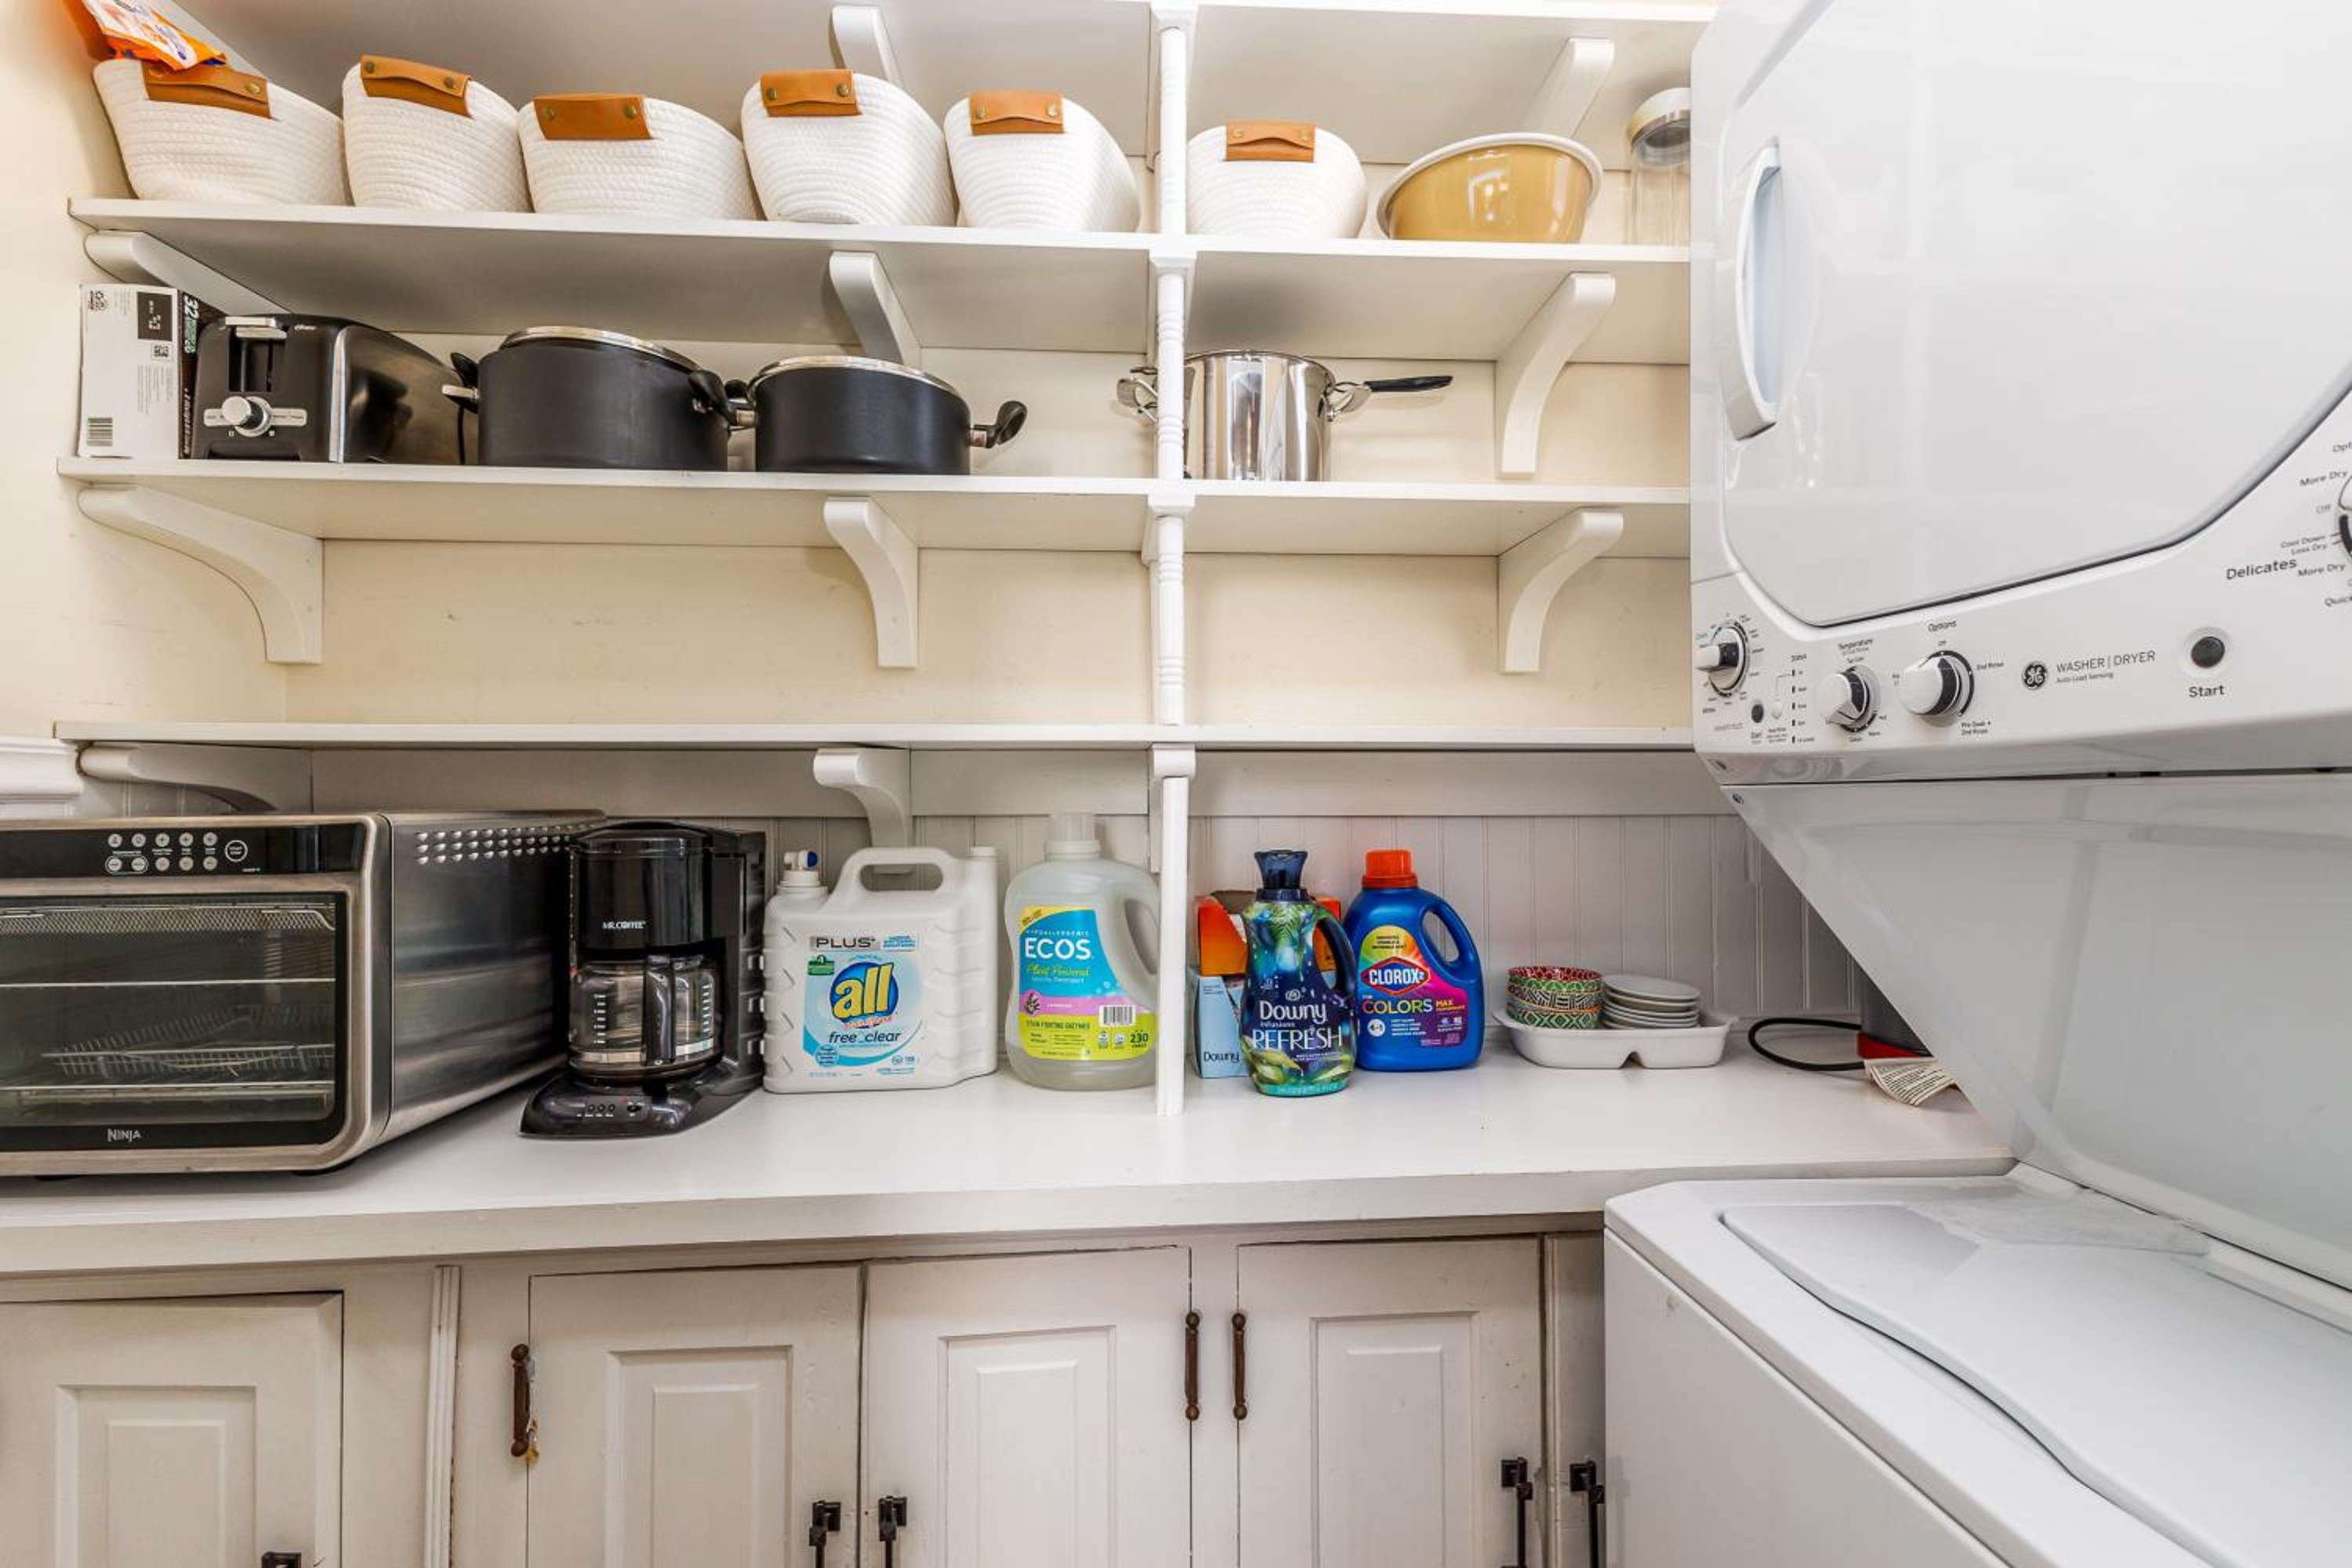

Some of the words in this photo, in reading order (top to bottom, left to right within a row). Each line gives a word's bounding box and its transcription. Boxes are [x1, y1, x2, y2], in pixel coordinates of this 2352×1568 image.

[2300, 475, 2326, 486] More
[2329, 470, 2347, 480] Dry
[2316, 504, 2332, 514] Off
[2281, 539, 2299, 548] Cool
[2301, 535, 2326, 545] Down
[2313, 543, 2328, 552] Dry
[2226, 558, 2297, 580] Delicates
[2298, 567, 2325, 577] More
[2327, 563, 2346, 572] Dry
[1928, 620, 1957, 632] Options
[2056, 658, 2105, 673] WASHER
[2114, 650, 2155, 666] DRYER
[2188, 685, 2226, 698] Start
[1025, 938, 1091, 960] ECOS
[833, 962, 894, 1020] all
[1259, 1000, 1326, 1025] Downy
[1363, 998, 1433, 1014] COLORS
[829, 1031, 857, 1044] free
[865, 1031, 901, 1042] clear
[1130, 1033, 1149, 1044] 230
[1252, 1025, 1342, 1051] REFRESH
[1203, 1051, 1240, 1064] Downy
[107, 1129, 141, 1142] NINJA
